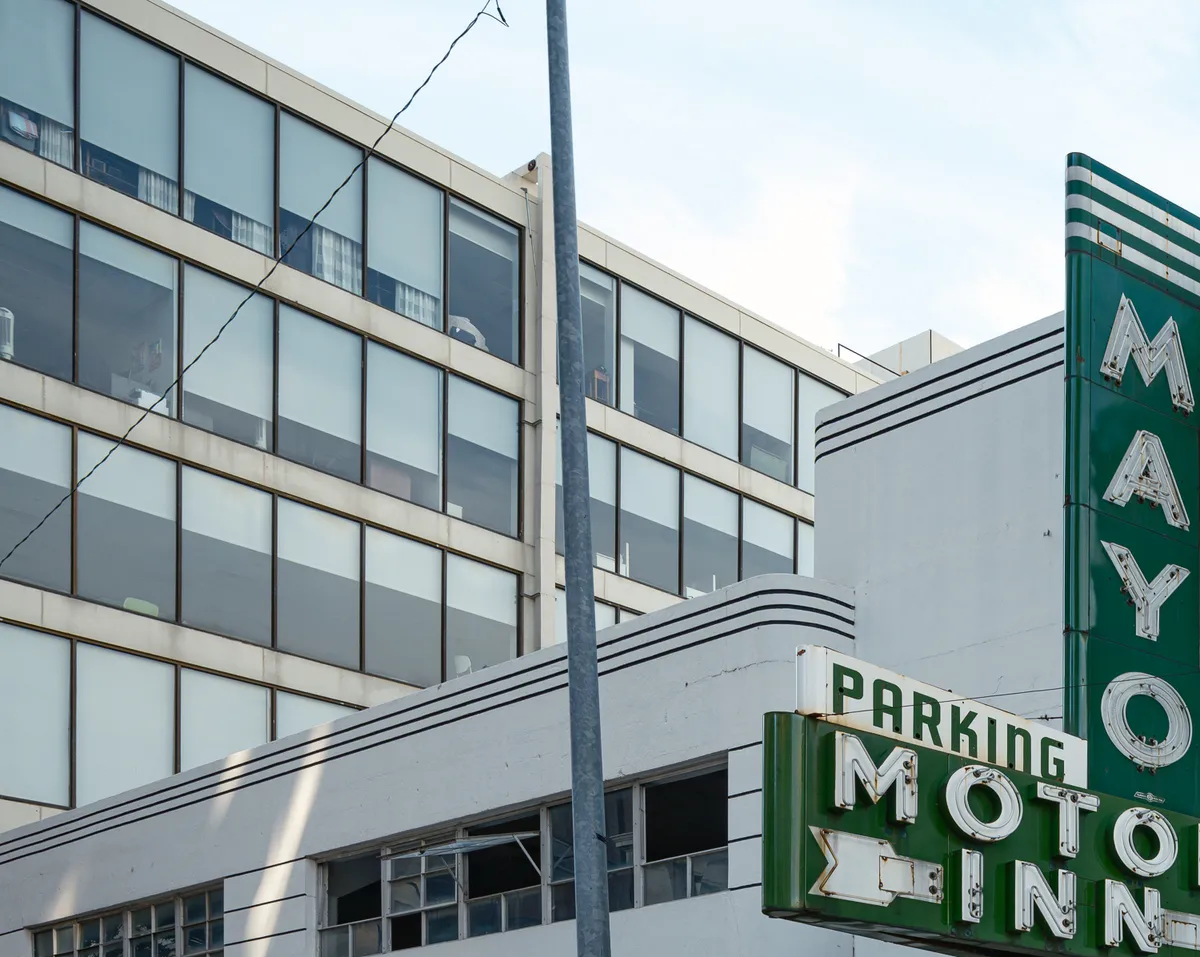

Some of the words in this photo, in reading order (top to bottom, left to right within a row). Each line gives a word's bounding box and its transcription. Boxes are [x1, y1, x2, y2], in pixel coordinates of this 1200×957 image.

[1100, 292, 1195, 769] MAYO
[833, 662, 1066, 782] PARKING
[961, 848, 1162, 953] INN
